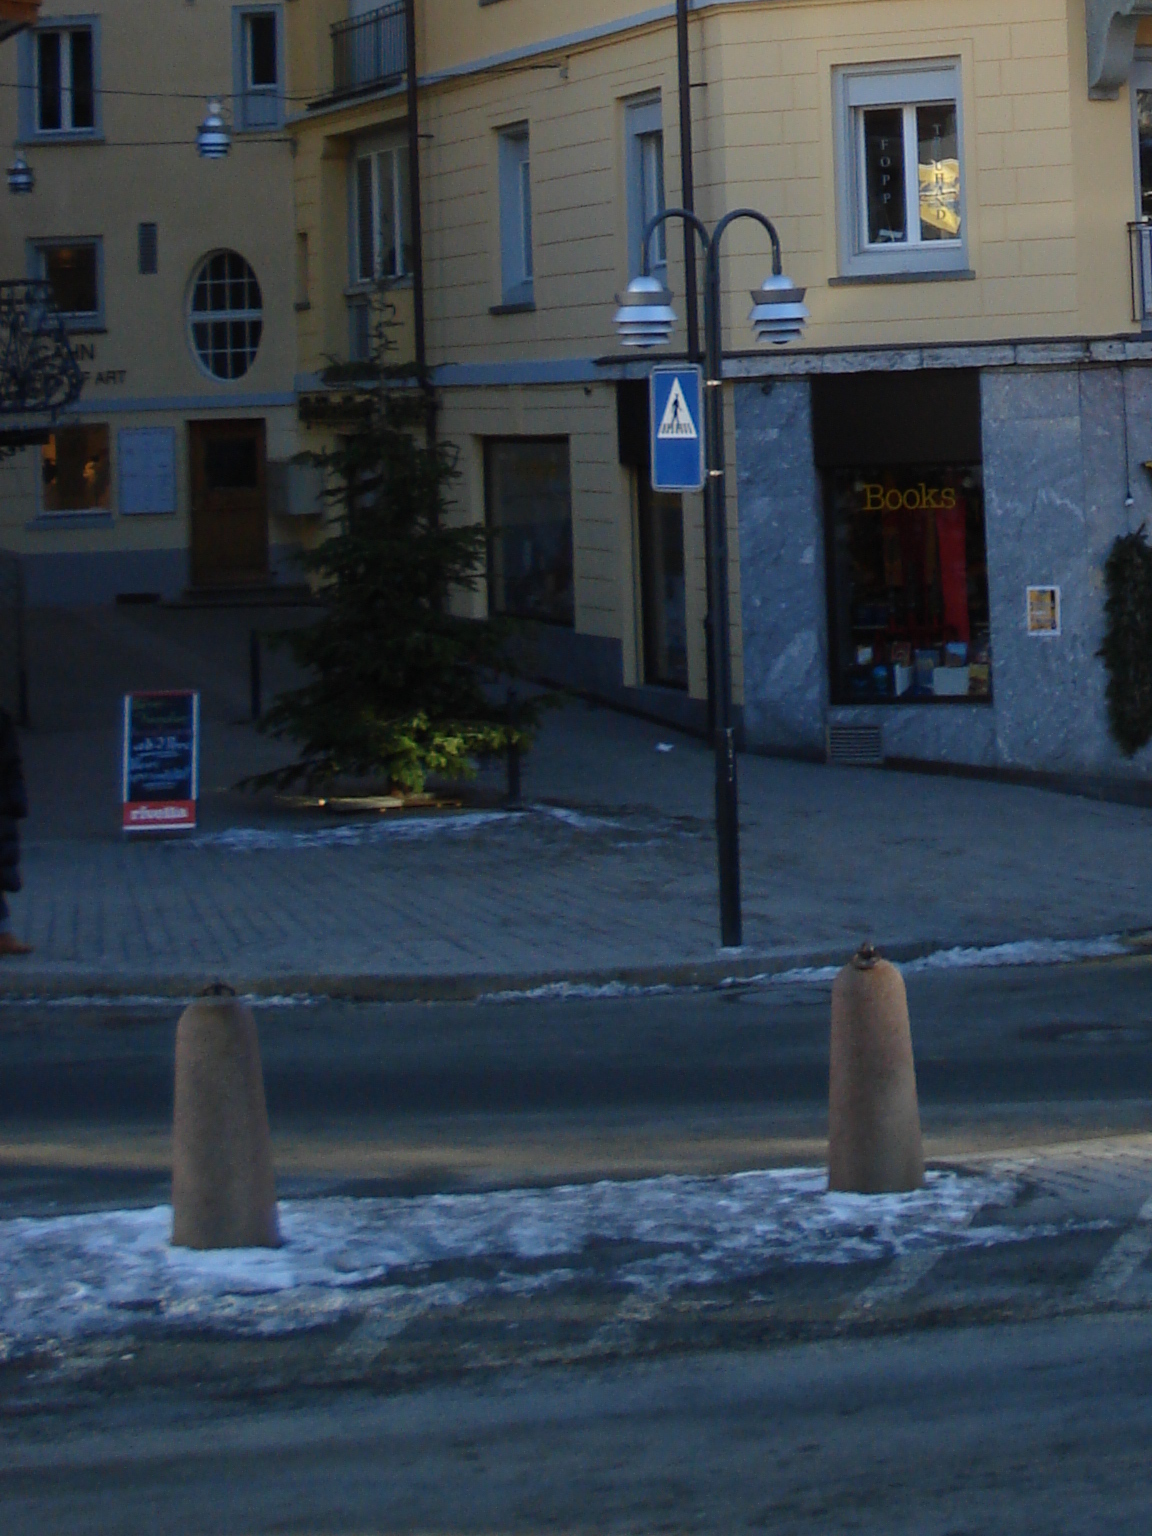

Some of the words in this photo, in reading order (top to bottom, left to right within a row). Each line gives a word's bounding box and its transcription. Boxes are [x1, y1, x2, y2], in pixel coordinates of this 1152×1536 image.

[880, 139, 891, 204] FOPP
[95, 370, 127, 385] ART
[863, 483, 956, 511] Books
